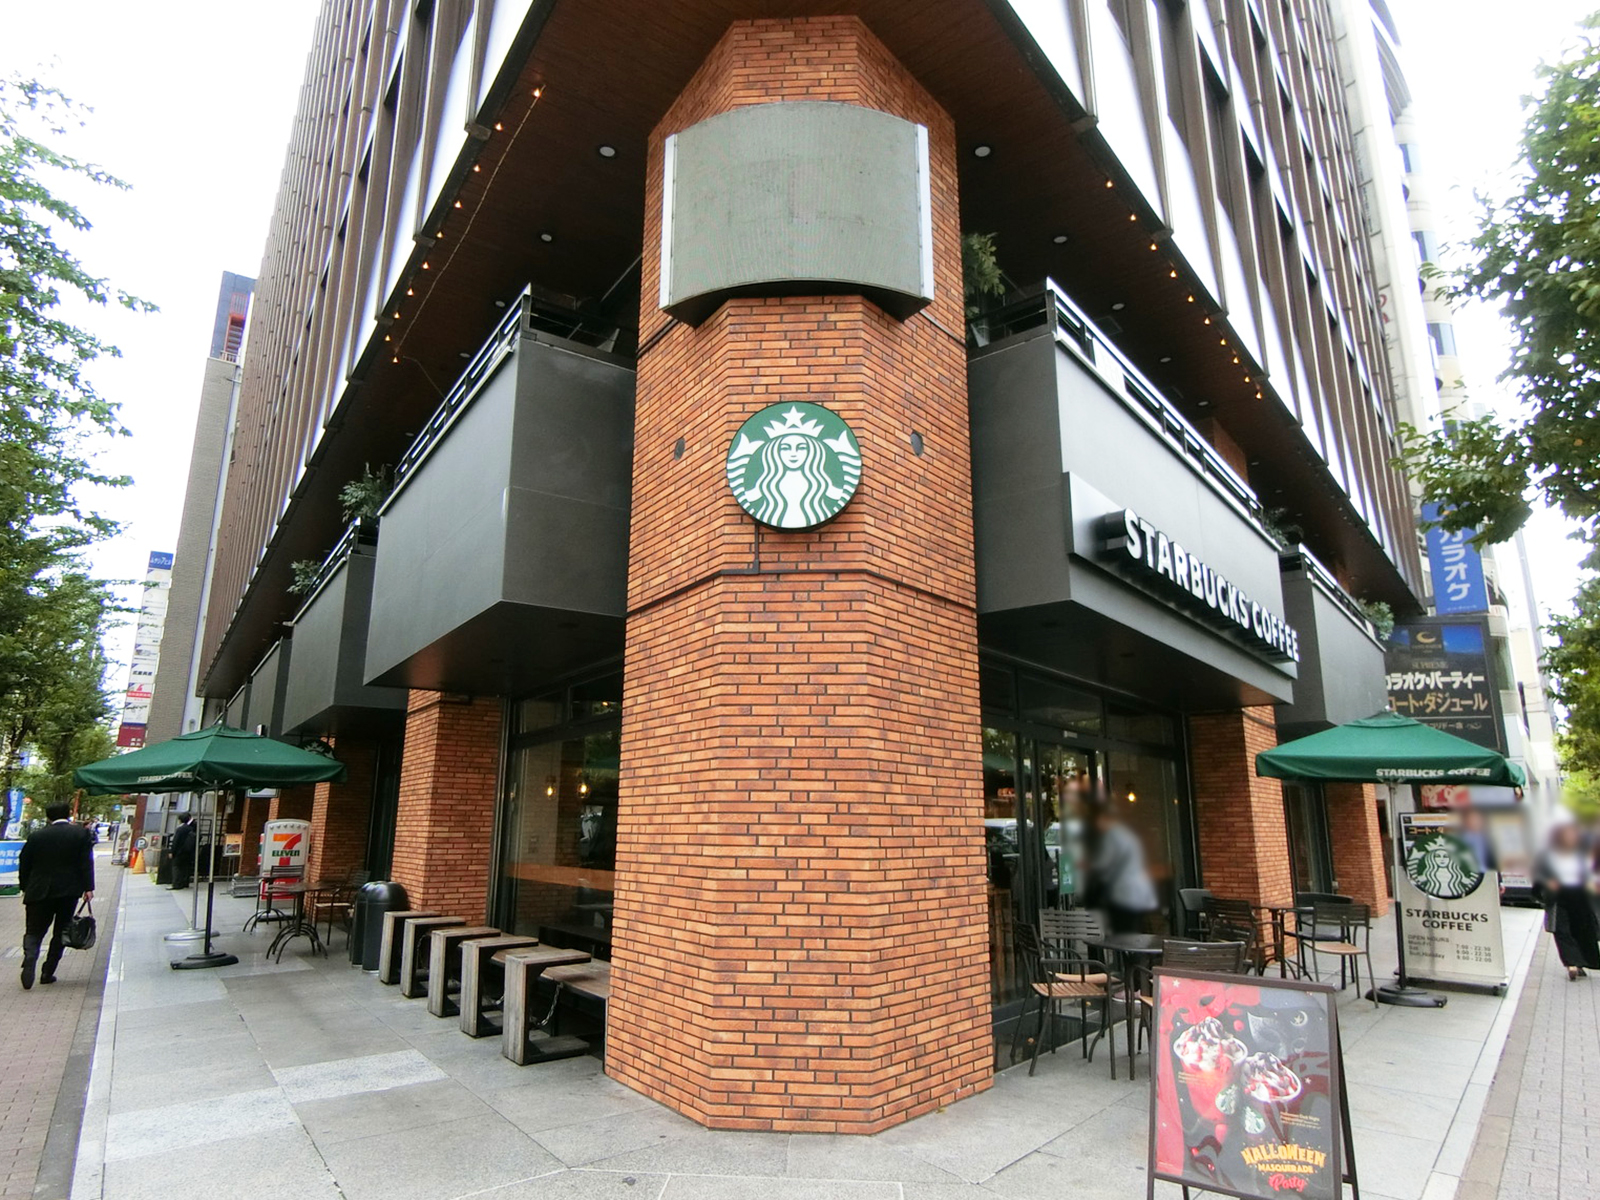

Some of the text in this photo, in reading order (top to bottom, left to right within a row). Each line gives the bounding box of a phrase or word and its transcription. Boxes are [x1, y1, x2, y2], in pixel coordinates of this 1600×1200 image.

[1440, 528, 1471, 602] カラオケ
[1124, 508, 1299, 662] STARBUCKS COFFEE
[1388, 692, 1489, 714] コート・ダジュール
[1376, 767, 1491, 777] STARBUCKS COFFEE
[137, 839, 145, 848] P
[273, 833, 302, 866] 7
[1405, 908, 1489, 923] STARBUCKS
[1422, 919, 1473, 932] COFFEE
[1240, 1143, 1327, 1168] HALLOWEEN
[1257, 1163, 1314, 1174] MASQUERADE
[1268, 1172, 1307, 1193] Party
